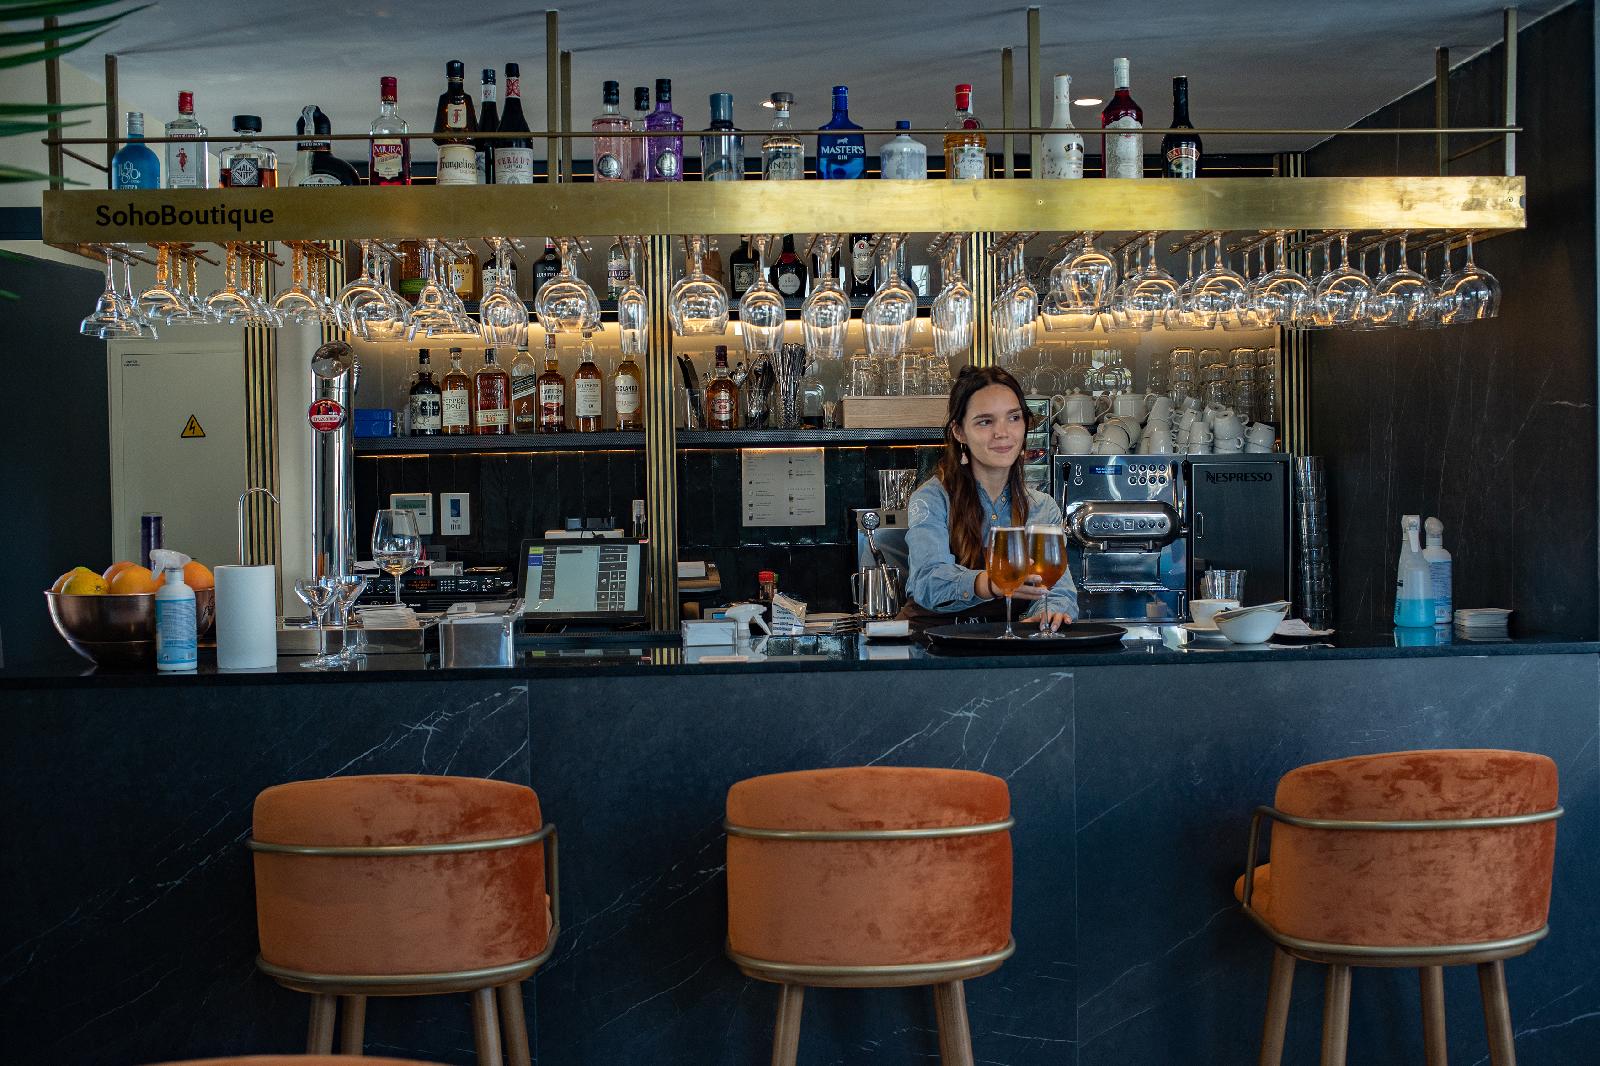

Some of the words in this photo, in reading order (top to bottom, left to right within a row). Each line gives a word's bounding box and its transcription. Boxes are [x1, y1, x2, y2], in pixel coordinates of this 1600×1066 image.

[374, 145, 402, 154] MIURA
[821, 146, 865, 154] MASTER'S
[96, 203, 274, 232] SohoBoutique
[1206, 471, 1273, 484] NESPRESSO
